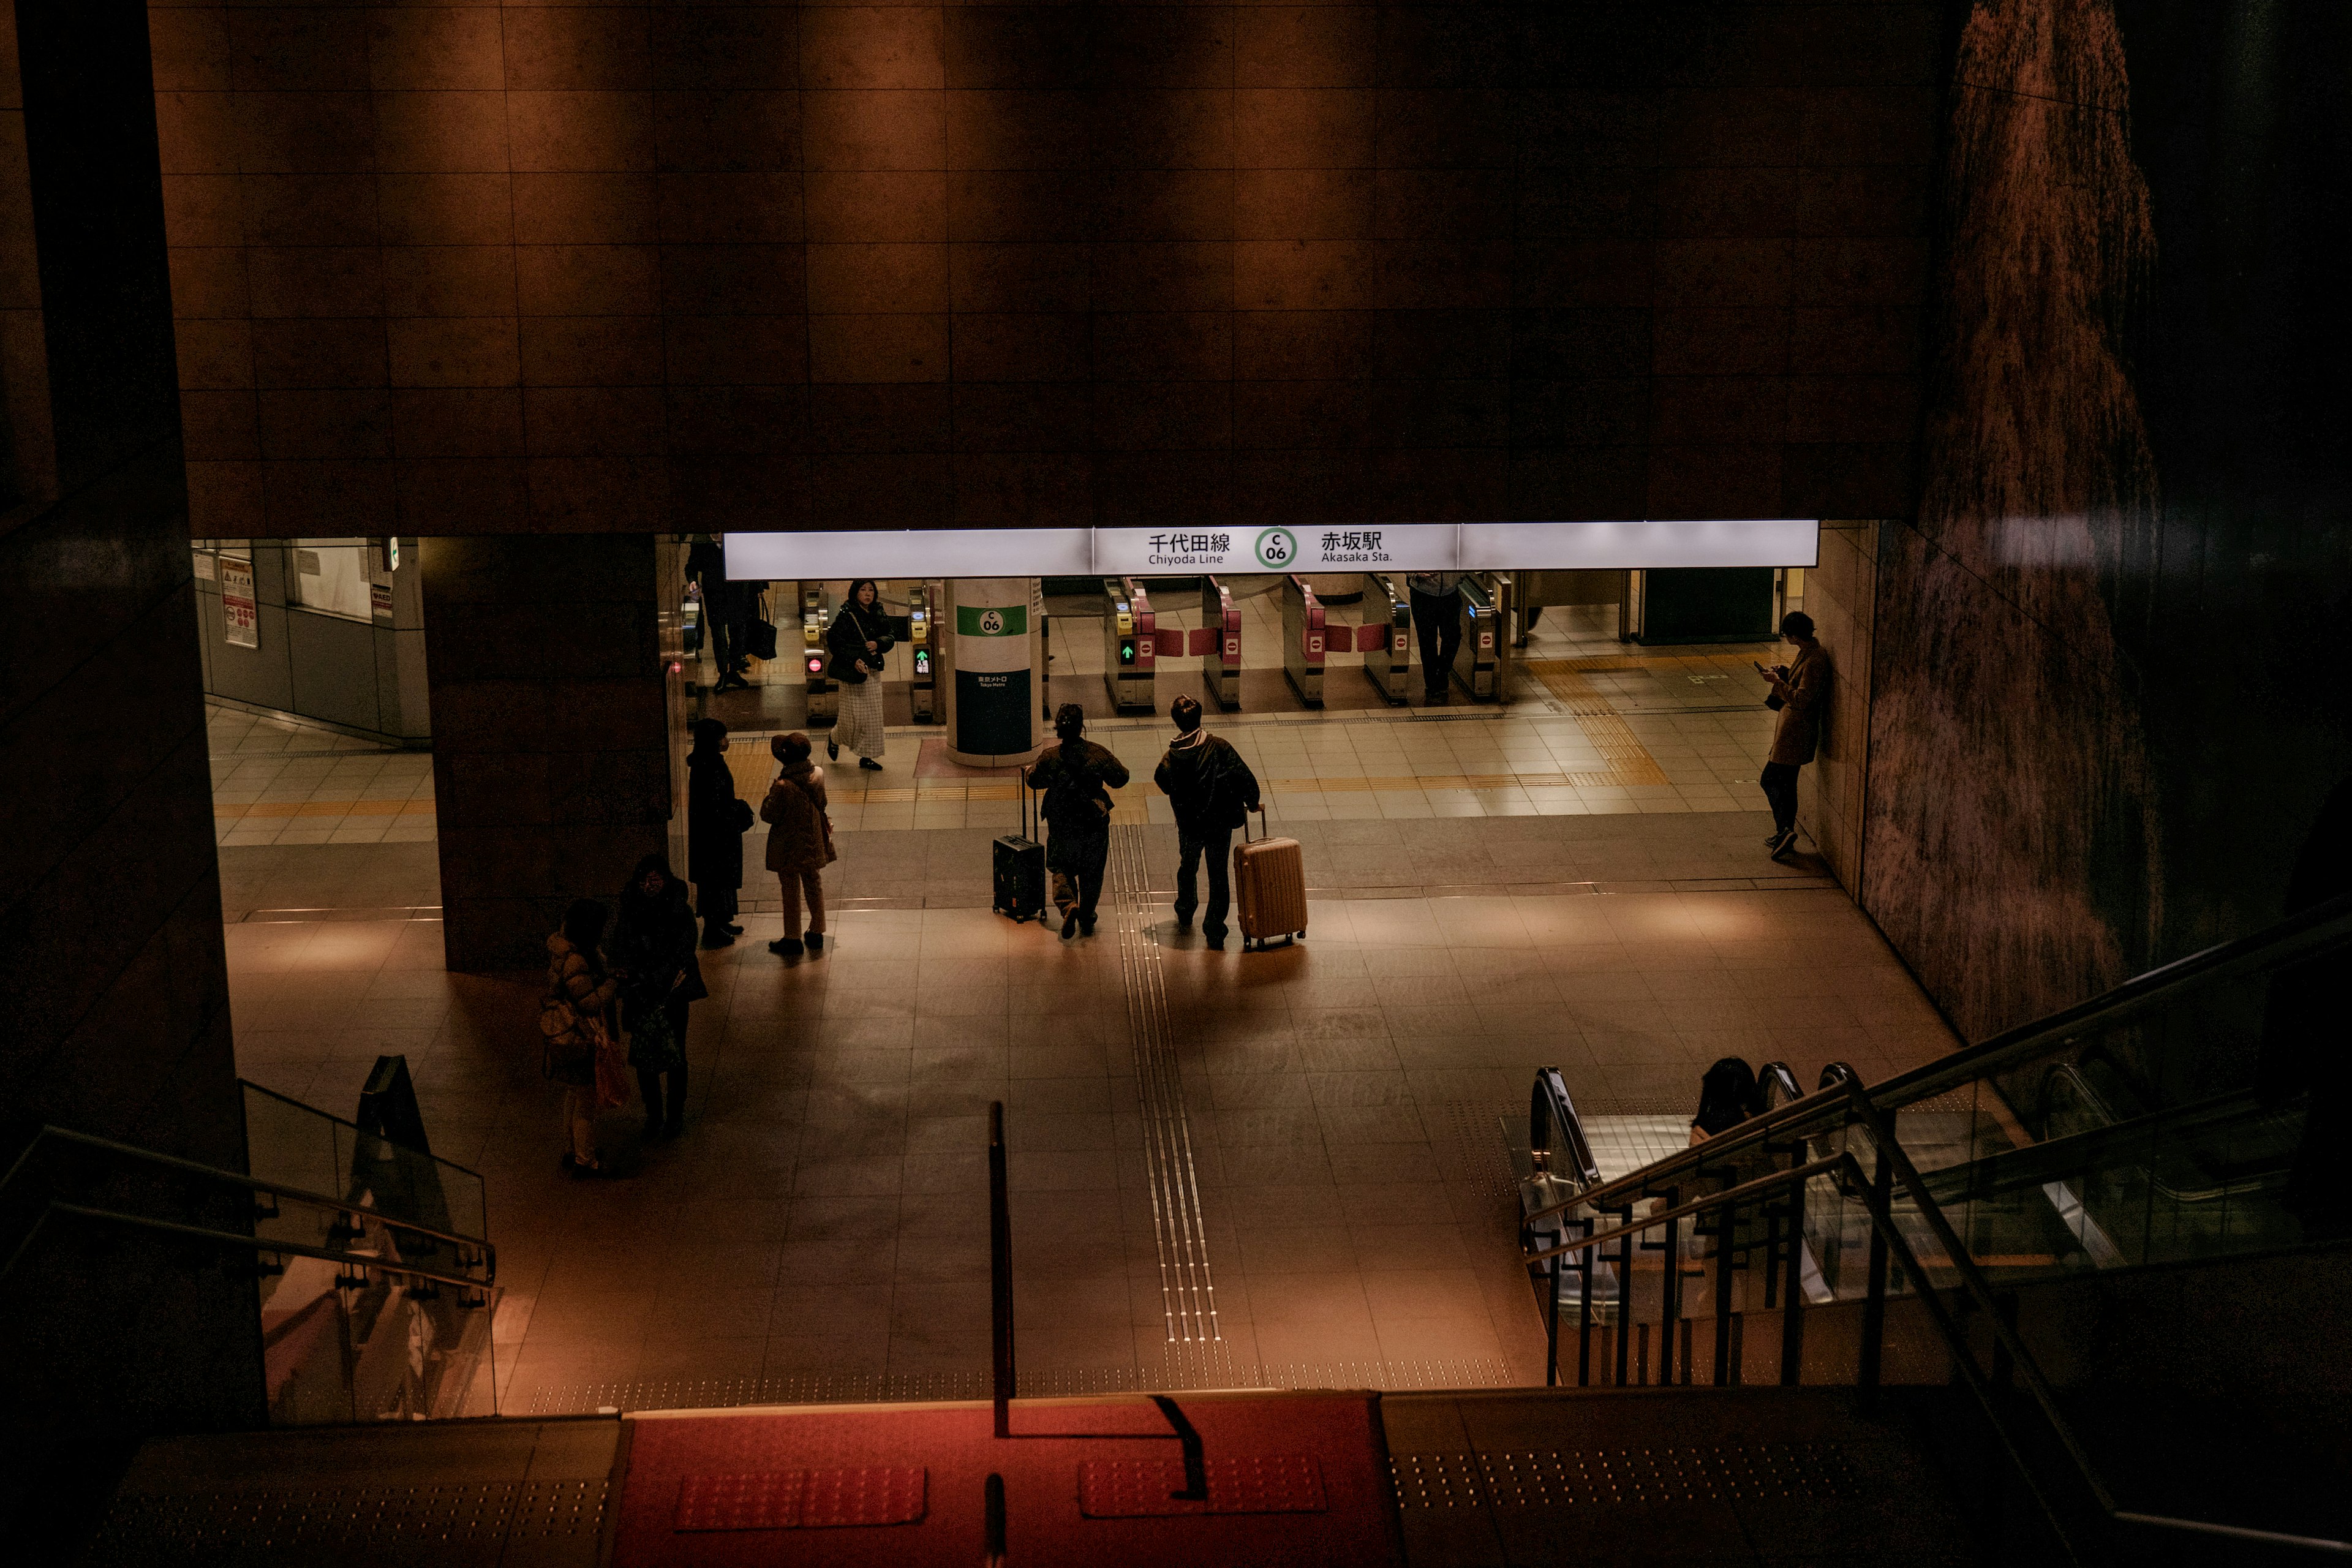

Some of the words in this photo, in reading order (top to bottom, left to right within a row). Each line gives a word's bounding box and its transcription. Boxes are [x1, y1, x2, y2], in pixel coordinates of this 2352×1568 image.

[1148, 533, 1230, 553] 千代田線
[1272, 534, 1280, 545] C
[1321, 532, 1382, 551] 赤坂駅
[1266, 547, 1286, 560] 06
[1321, 552, 1368, 562] Akasaka
[1372, 552, 1392, 562] Sta.
[1148, 554, 1196, 566] Chiyoda
[1199, 554, 1223, 564] Line
[378, 593, 391, 601] AED
[983, 620, 1000, 631] 06
